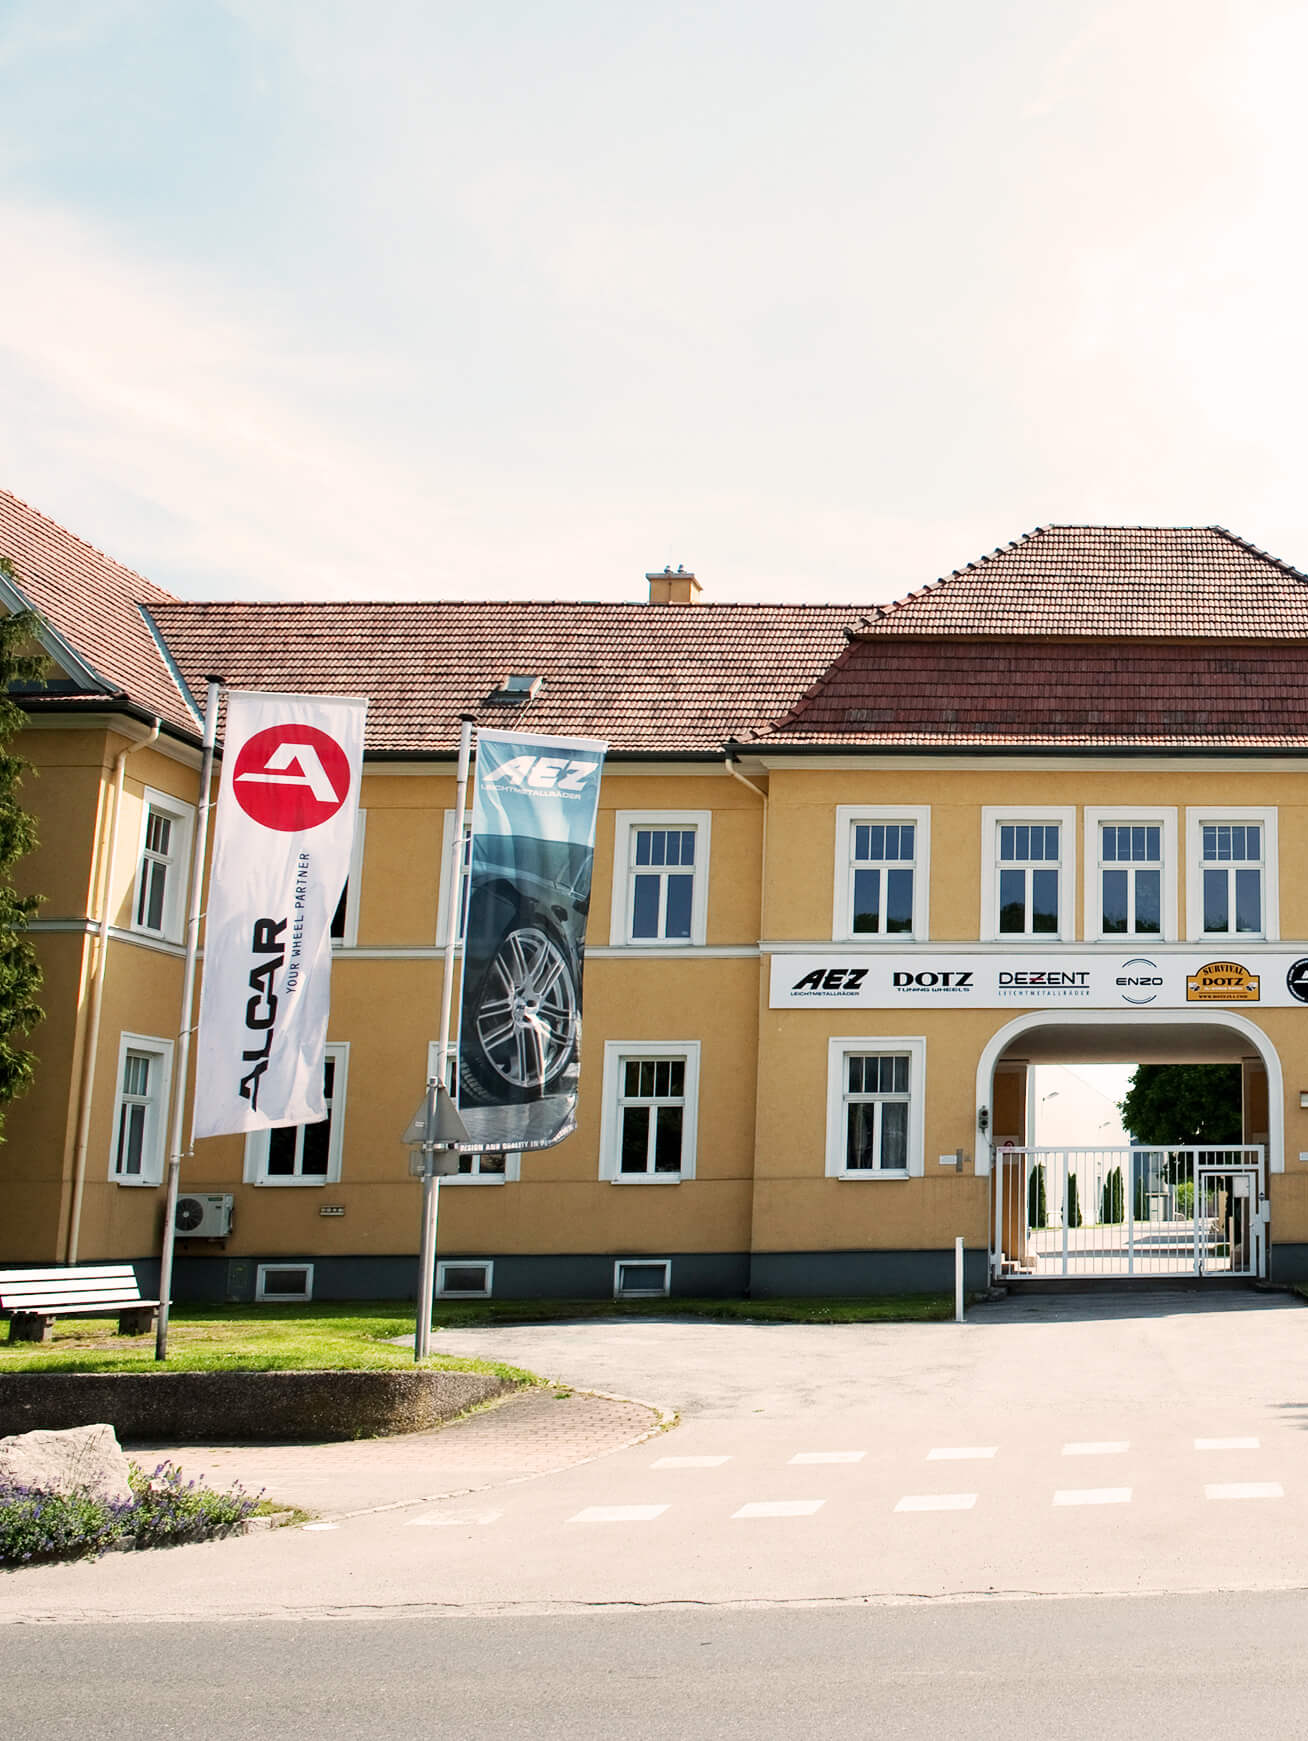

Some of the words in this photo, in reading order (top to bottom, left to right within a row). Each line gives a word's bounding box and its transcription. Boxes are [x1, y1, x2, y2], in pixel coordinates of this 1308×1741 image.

[482, 755, 600, 792] AEZ
[294, 852, 310, 909] PARTNER
[291, 914, 305, 958] WHEEL
[286, 962, 300, 995] YOUR
[791, 968, 870, 990] AEZ
[893, 971, 975, 987] DOTZ
[998, 971, 1091, 985] DEZENT
[1202, 964, 1244, 975] SURVIVAL
[1115, 976, 1164, 986] ENZO
[1202, 977, 1244, 986] DOTZ
[239, 916, 288, 1113] ALCAR
